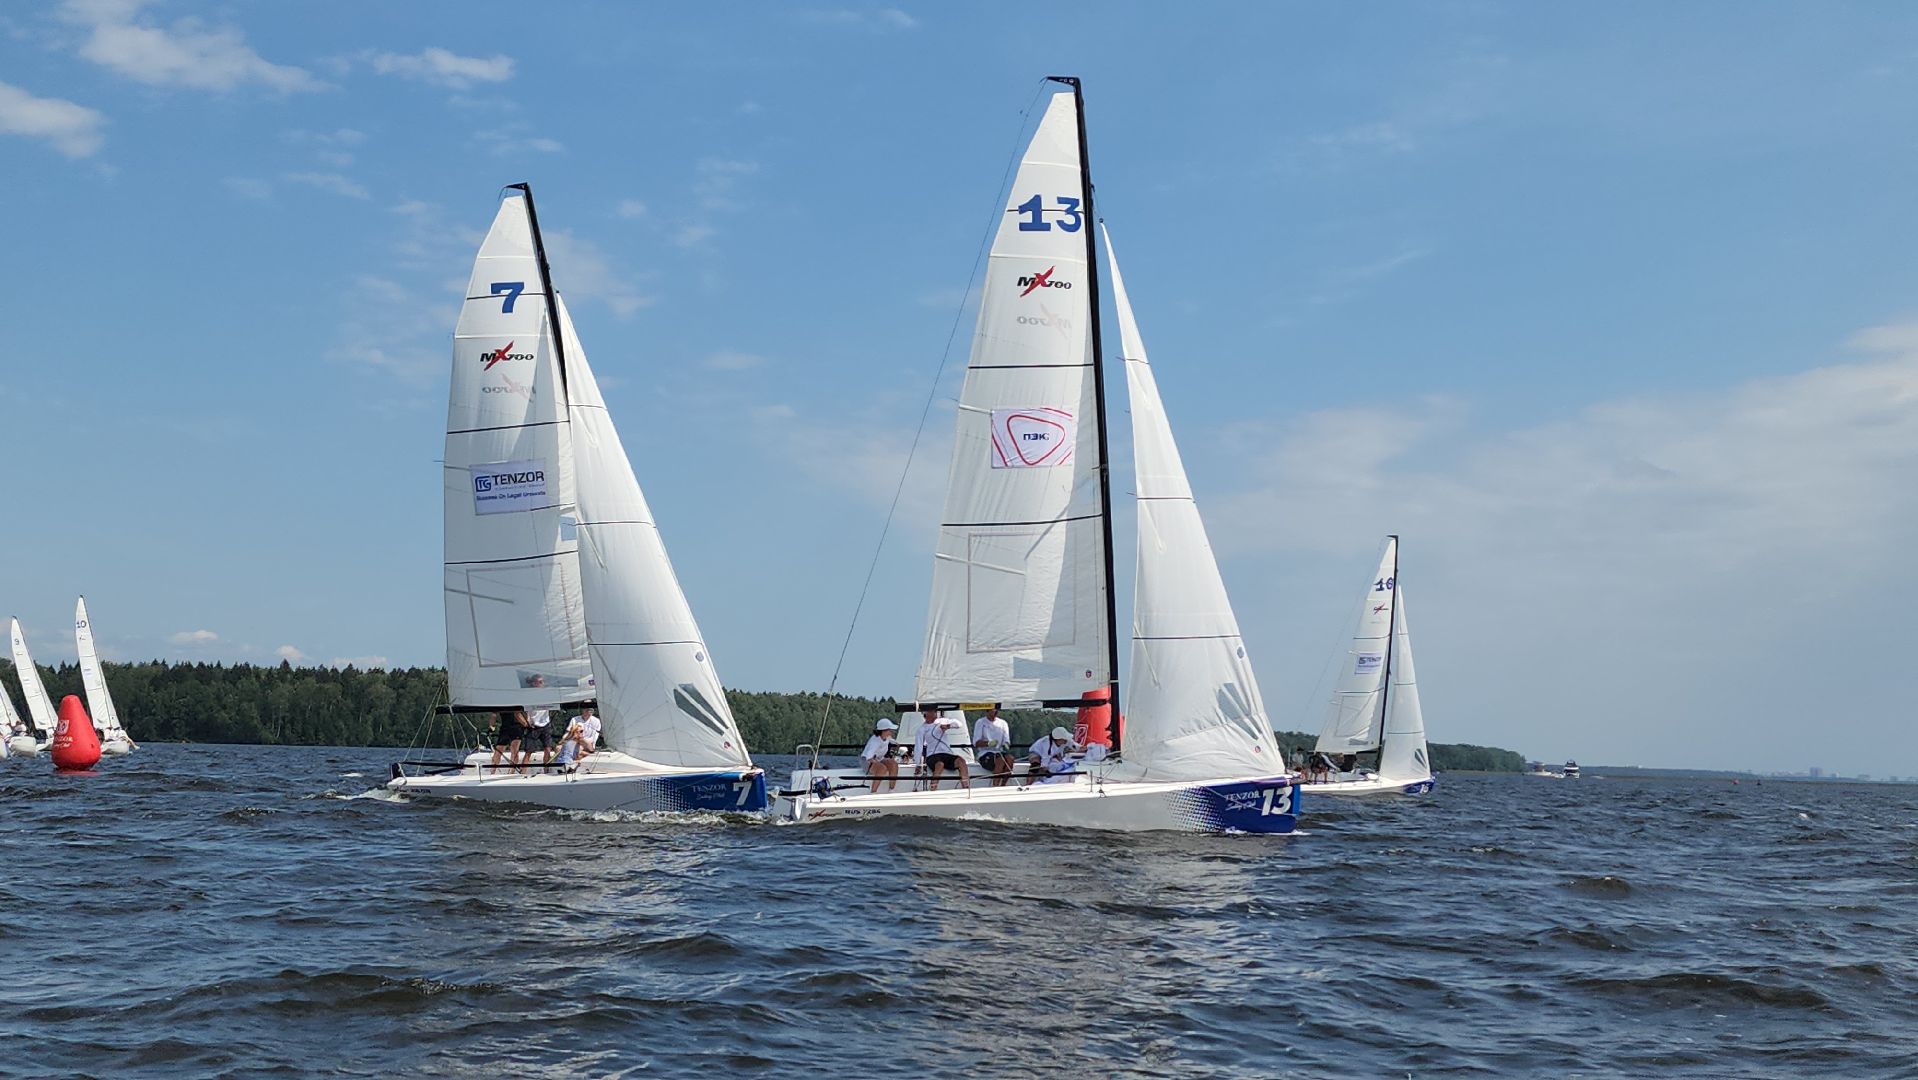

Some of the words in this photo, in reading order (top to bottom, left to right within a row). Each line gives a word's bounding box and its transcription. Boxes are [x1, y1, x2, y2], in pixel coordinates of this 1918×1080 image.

[1018, 194, 1082, 232] 13
[1017, 265, 1072, 297] MX700
[490, 282, 525, 313] 7
[480, 340, 535, 371] MX700
[492, 470, 545, 486] TENZOR
[733, 781, 753, 806] 7
[1225, 790, 1260, 800] TENZOR
[1261, 786, 1293, 816] 13
